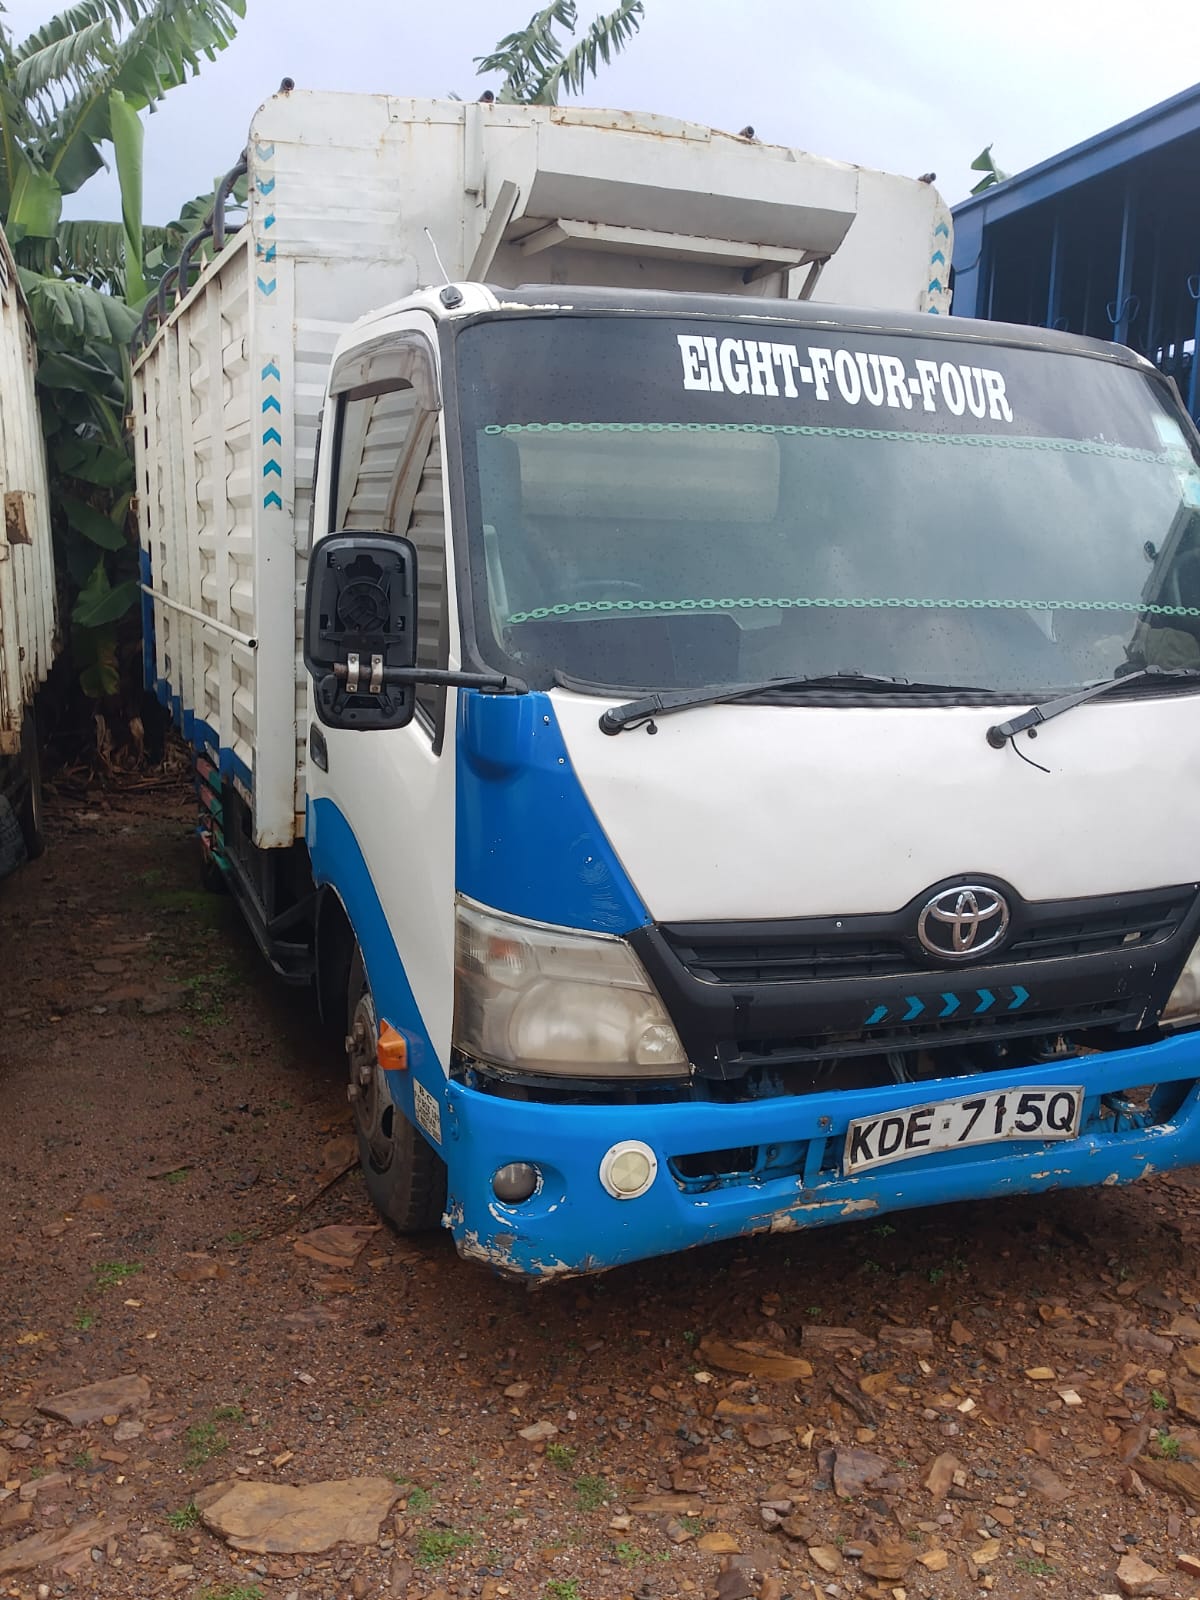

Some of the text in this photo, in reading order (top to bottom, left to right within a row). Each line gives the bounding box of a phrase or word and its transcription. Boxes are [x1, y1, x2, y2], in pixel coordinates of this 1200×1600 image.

[677, 334, 1014, 423] EIGHT-FOUR-FOUR
[850, 1092, 1076, 1164] KDE 715Q
